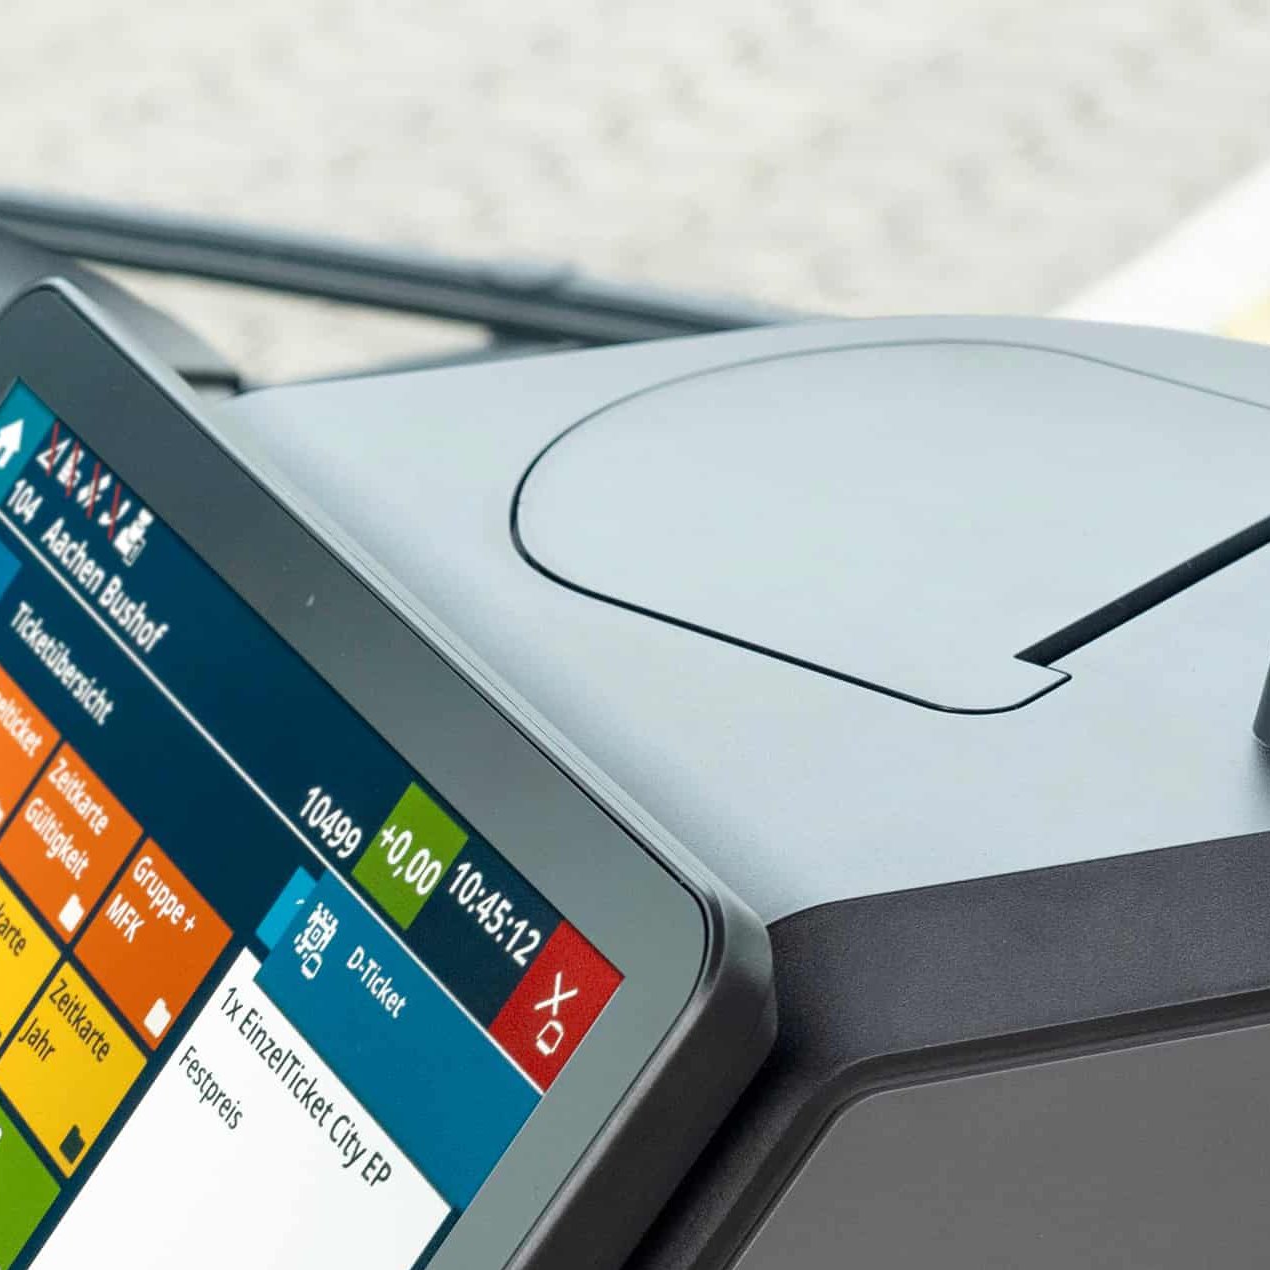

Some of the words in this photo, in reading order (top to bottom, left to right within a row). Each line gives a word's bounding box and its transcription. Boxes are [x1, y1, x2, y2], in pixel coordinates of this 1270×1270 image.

[8, 480, 42, 523] 104
[41, 518, 105, 594] Aachen
[99, 576, 168, 652] Bushof
[11, 601, 113, 725] Ticketübersicht
[48, 758, 108, 835] Zeitkarte
[300, 787, 361, 858] 10499
[25, 798, 88, 880] Gültigkeit
[381, 826, 441, 895] +0,00
[106, 894, 144, 942] MFK
[133, 856, 185, 924] Gruppe
[184, 916, 195, 931] +
[449, 863, 540, 966] 10:45:12
[49, 979, 110, 1062] Zeitkarte
[347, 946, 405, 1018] D-Ticket
[18, 1017, 56, 1063] Jahr
[179, 1046, 242, 1129] Festpreis
[221, 987, 243, 1021] 1x
[239, 1008, 333, 1127] EinzelTicket
[330, 1115, 367, 1168] City
[361, 1152, 391, 1186] EP
